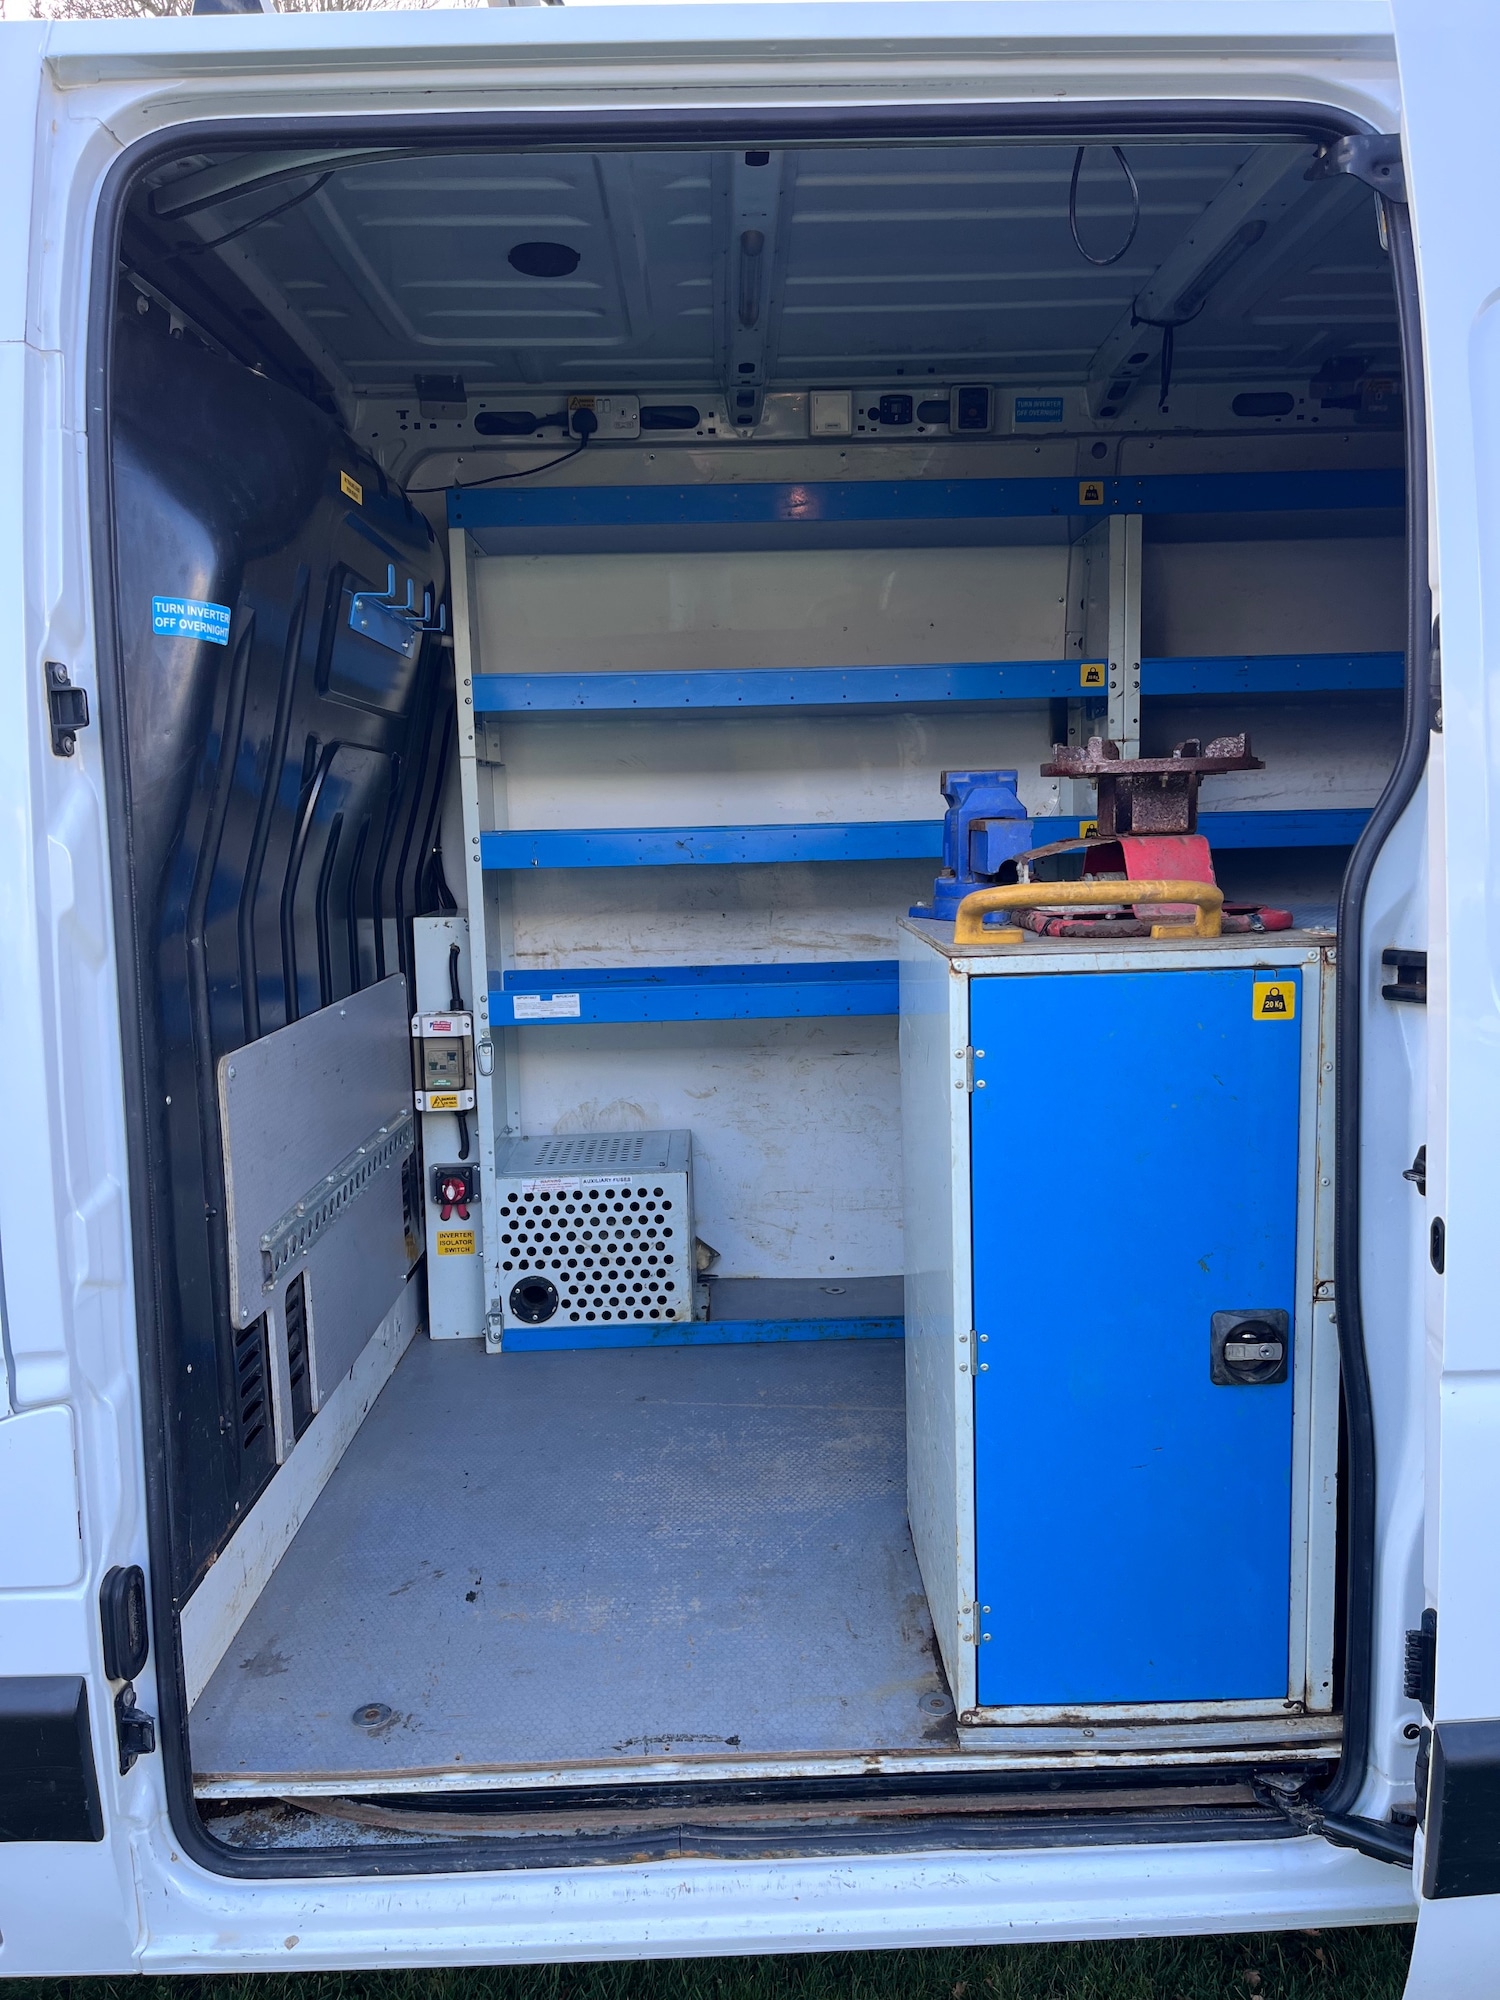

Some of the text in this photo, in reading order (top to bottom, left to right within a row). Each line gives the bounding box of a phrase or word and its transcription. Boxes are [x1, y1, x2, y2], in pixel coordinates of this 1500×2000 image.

[155, 602, 230, 623] TURN INVERTER
[155, 617, 229, 637] OFF OVERNIGHT
[1265, 1000, 1283, 1010] 20 Kg
